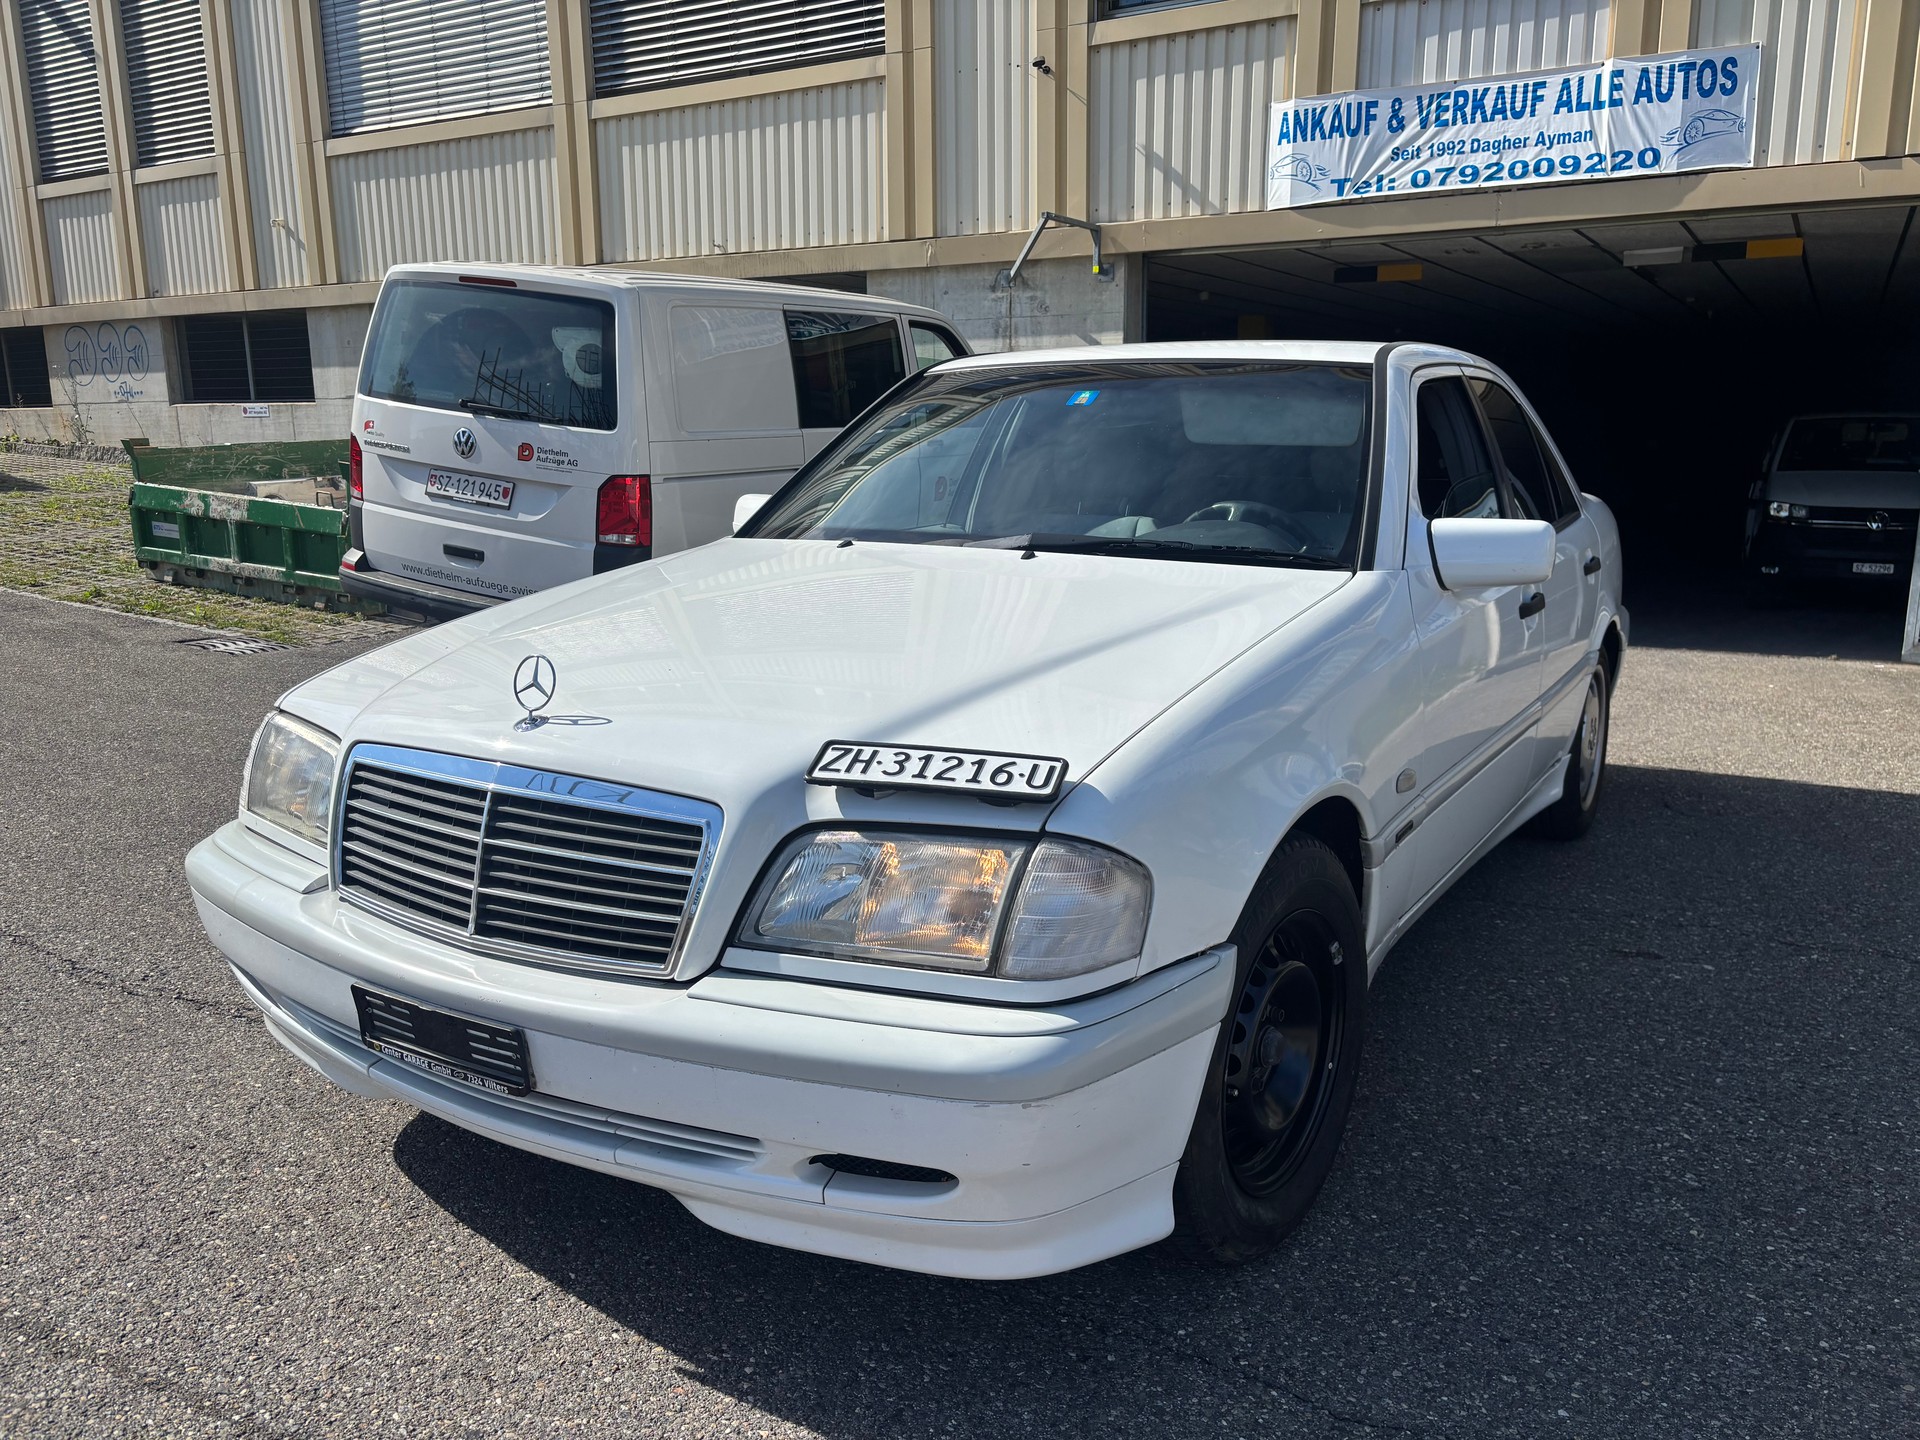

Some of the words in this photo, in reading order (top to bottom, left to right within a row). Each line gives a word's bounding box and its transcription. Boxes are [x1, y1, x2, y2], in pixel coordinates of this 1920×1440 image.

[1278, 99, 1379, 146] ANKAUF
[1387, 97, 1406, 134] &
[1416, 80, 1547, 130] VERKAUF
[1553, 69, 1625, 115] ALLE
[1632, 56, 1739, 106] AUTOS
[1390, 145, 1421, 162] Seit
[1427, 139, 1465, 159] 1992
[1470, 131, 1530, 155] Dagher
[1534, 129, 1593, 150] Ayman
[1329, 175, 1396, 198] Tel:
[1410, 146, 1661, 188] 0792009220
[535, 454, 565, 467] Aufzüge
[566, 458, 579, 467] AG
[536, 446, 569, 458] Diethelm
[381, 1045, 402, 1059] Center
[403, 1053, 429, 1069] GARAGE
[431, 1062, 452, 1076] GmbH
[467, 1073, 483, 1086] 7324
[484, 1079, 509, 1094] Vilters
